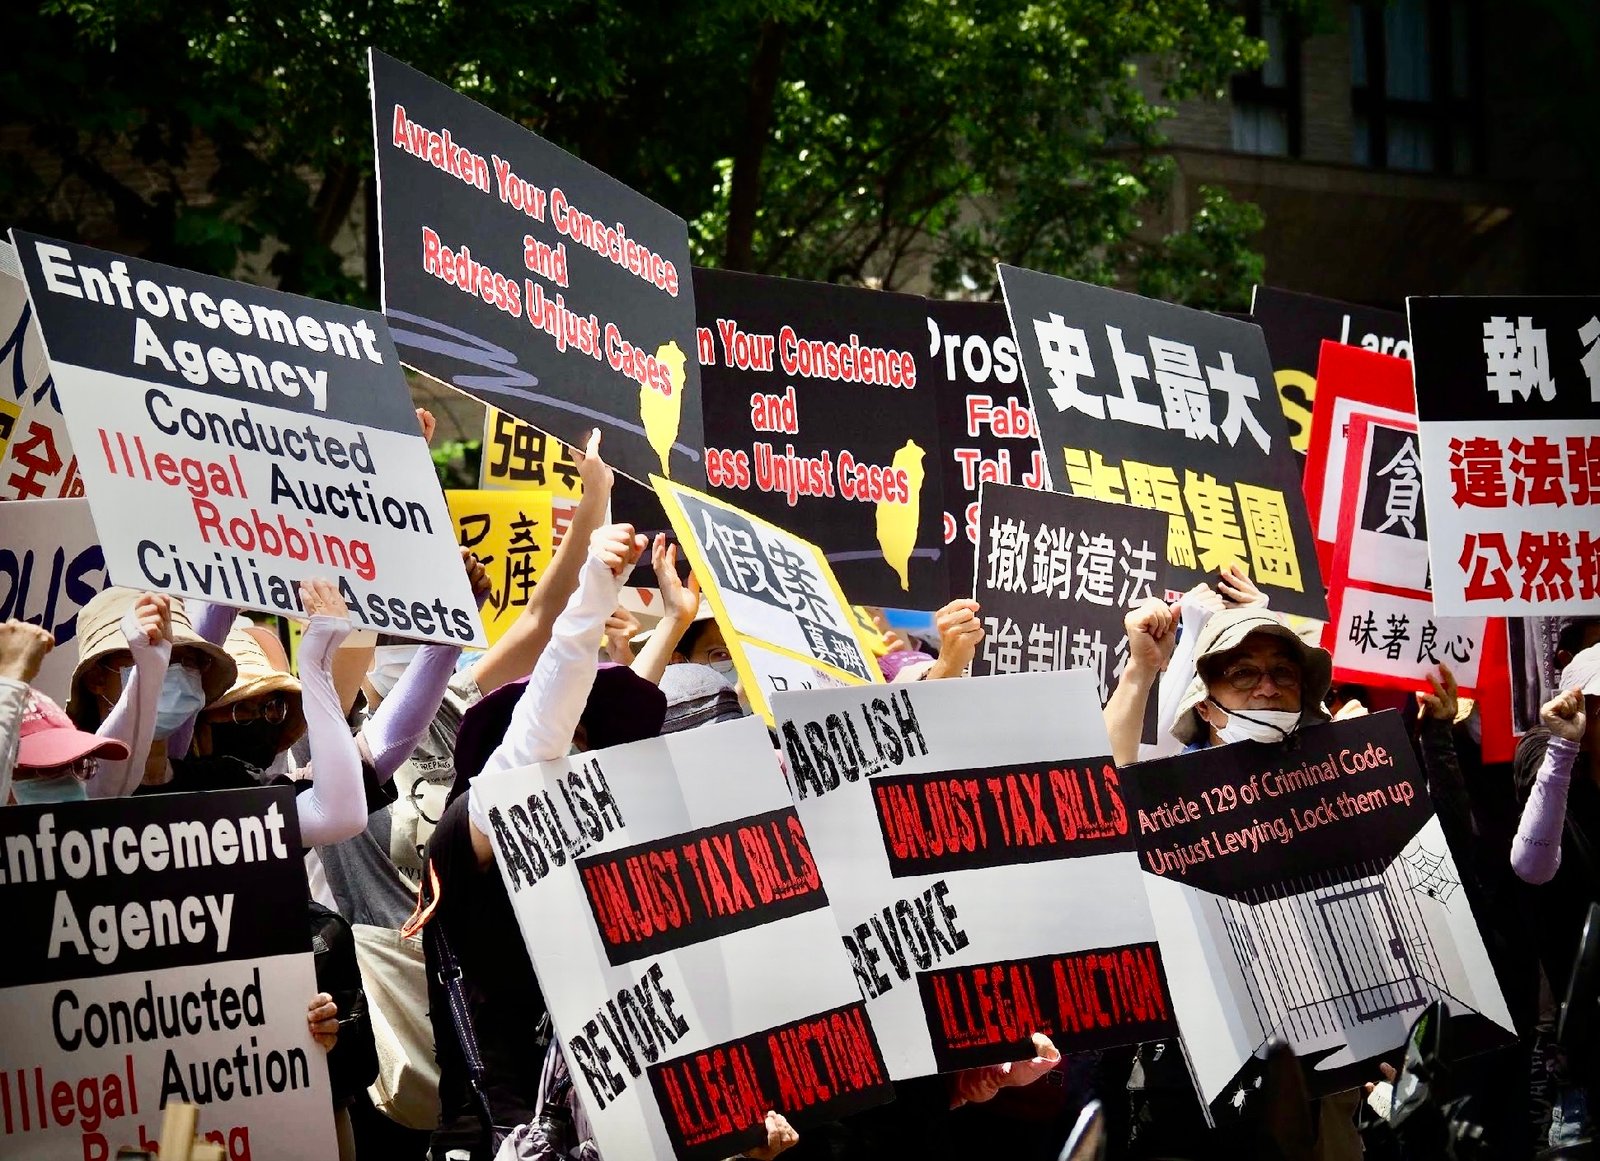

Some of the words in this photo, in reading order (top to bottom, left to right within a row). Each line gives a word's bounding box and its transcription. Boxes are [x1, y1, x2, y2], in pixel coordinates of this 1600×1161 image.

[393, 104, 490, 193] Awaken
[491, 154, 546, 222] Your
[550, 188, 680, 297] Conscience
[35, 241, 384, 364] Enforcement
[524, 234, 569, 288] and
[422, 226, 522, 318] Redress
[524, 279, 602, 361] Unjust
[605, 322, 673, 396] Cases
[716, 319, 775, 372] Your
[778, 325, 917, 389] Conscience
[133, 318, 328, 411] Agency
[751, 386, 799, 434] and
[1033, 312, 1272, 456] 史上最大
[144, 388, 377, 475] Conducted
[753, 442, 835, 506] Unjust
[837, 449, 909, 504] Cases
[98, 428, 248, 499] Illegal
[270, 464, 434, 535] Auction
[1375, 436, 1422, 539] 貪
[191, 497, 377, 581] Robbing
[700, 508, 838, 628] 假案
[986, 516, 1157, 609] 撤銷違法
[337, 576, 475, 642] Assets
[1349, 610, 1474, 667] 昧著良心
[781, 689, 928, 801] ABOLISH
[1138, 797, 1201, 835] Article
[1201, 784, 1238, 816] 129
[1239, 773, 1260, 805] of
[1261, 753, 1340, 798] Criminal
[1338, 743, 1394, 776] Code,
[0, 801, 288, 885] nforcement
[488, 758, 626, 892] ABOLISH
[876, 778, 987, 859] UNJUST
[987, 772, 1056, 847] TAX
[1049, 764, 1132, 841] BILLS
[1146, 836, 1215, 876] Unjust
[1213, 813, 1294, 856] Levying,
[1293, 802, 1338, 834] Lock
[1336, 789, 1389, 817] them
[1387, 780, 1415, 808] up
[48, 890, 235, 964] Agency
[587, 845, 693, 945] UNJUST
[686, 836, 754, 917] TAX
[743, 815, 822, 904] BILLS
[842, 879, 969, 1000] REVOKE
[52, 967, 265, 1051] Conducted
[569, 962, 690, 1110] REVOKE
[932, 964, 1052, 1049] ILLEGAL
[1053, 947, 1168, 1034] AUCTION
[0, 1055, 138, 1134] Illegal
[159, 1035, 310, 1111] Auction
[661, 1043, 772, 1147] ILLEGAL
[768, 1008, 884, 1110] AUCTION
